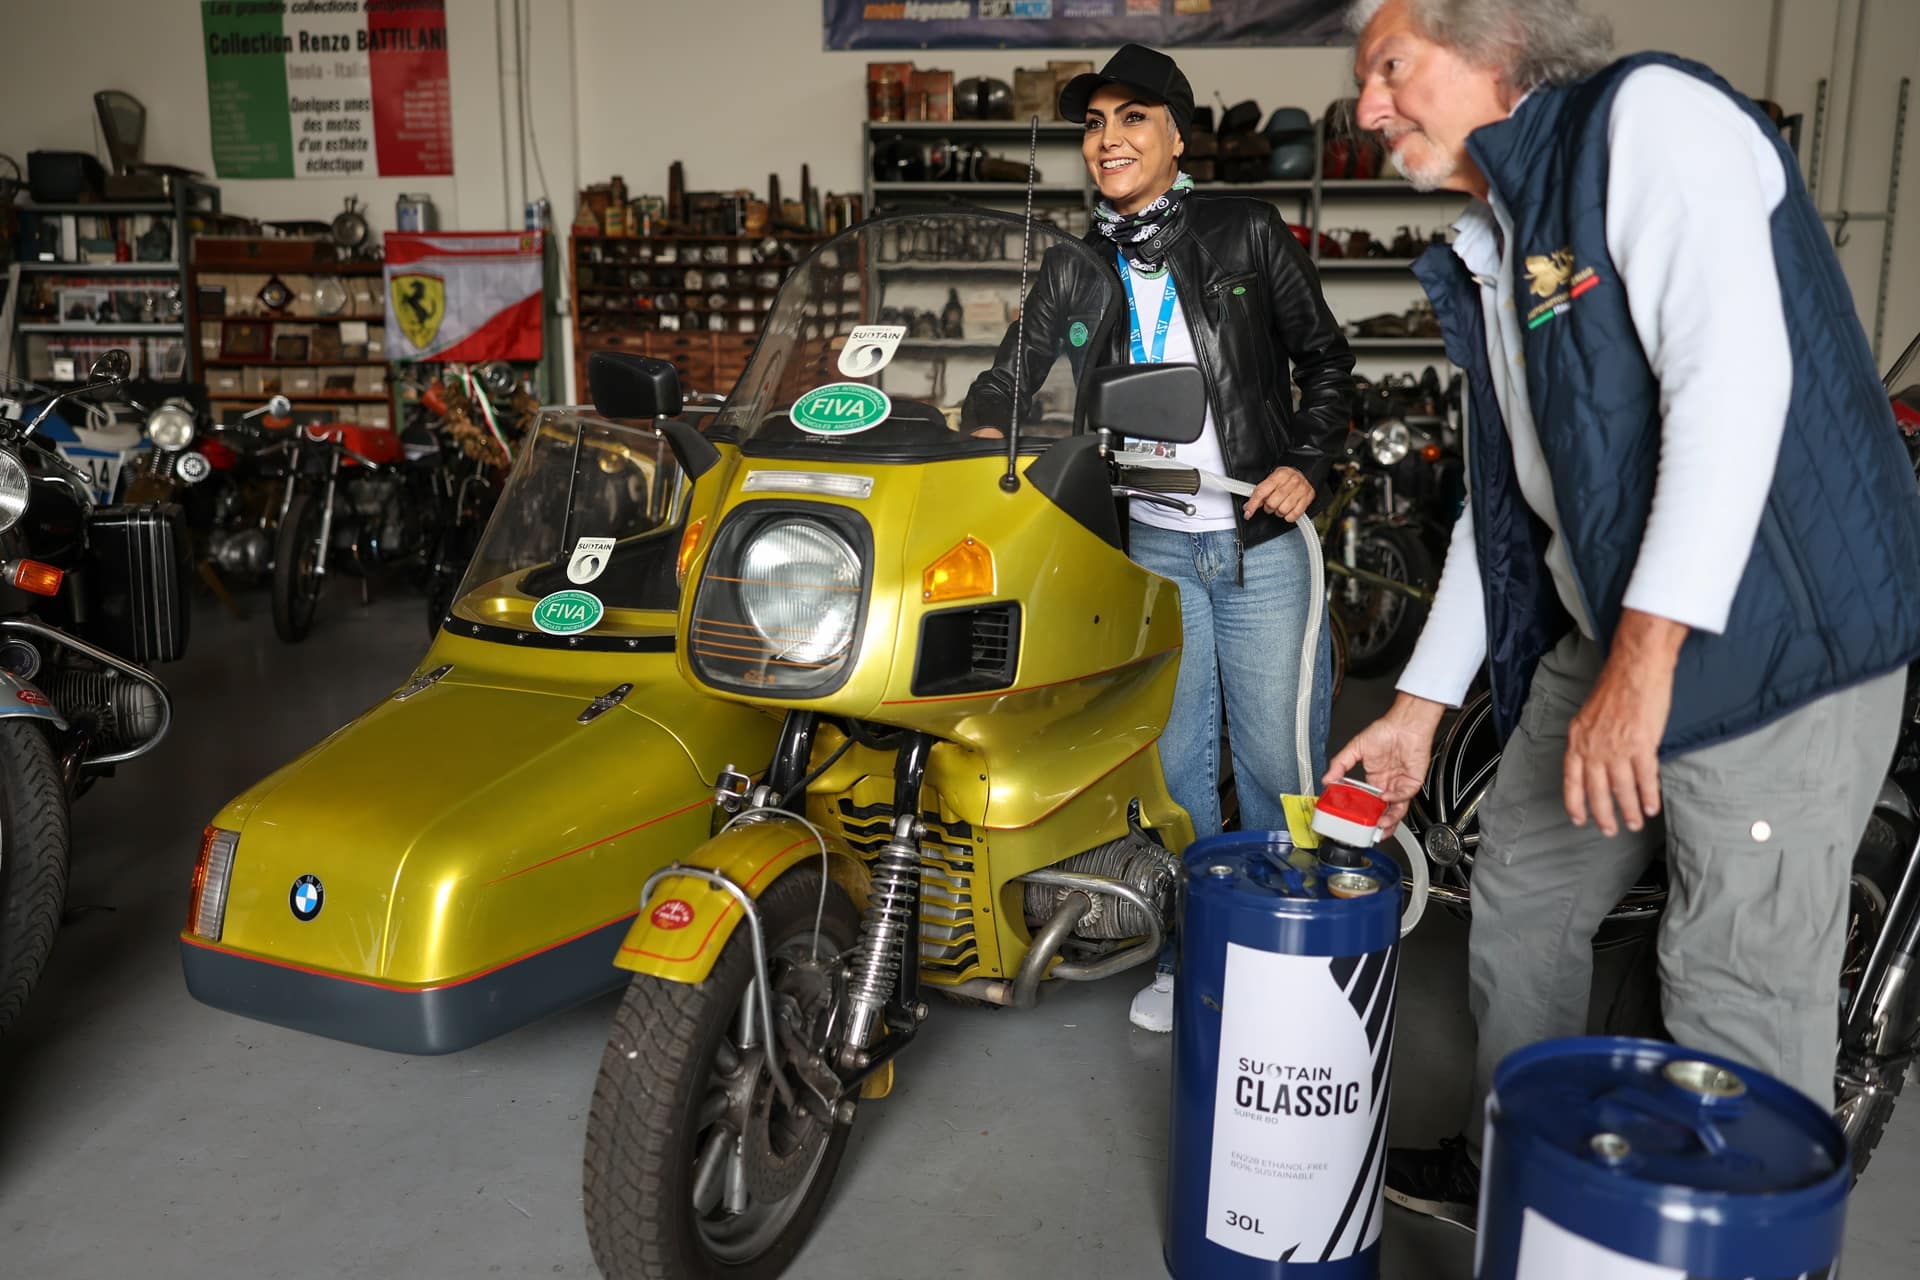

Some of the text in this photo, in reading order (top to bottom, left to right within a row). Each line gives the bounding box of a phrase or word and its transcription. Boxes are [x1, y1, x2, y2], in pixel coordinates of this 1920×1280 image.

[291, 0, 358, 13] collections
[209, 32, 293, 55] Collection
[299, 30, 350, 52] Renzo
[289, 98, 370, 114] Quelques unes
[303, 118, 361, 132] des motos
[299, 137, 323, 151] d'un
[809, 398, 865, 418] FIVA
[546, 603, 586, 620] FIVA
[295, 875, 323, 893] BMW
[1236, 1076, 1360, 1117] CLASSIC
[1233, 1108, 1263, 1122] SUPER
[1254, 1166, 1315, 1180] SUSTAINABLE
[1225, 1210, 1265, 1235] 30L
